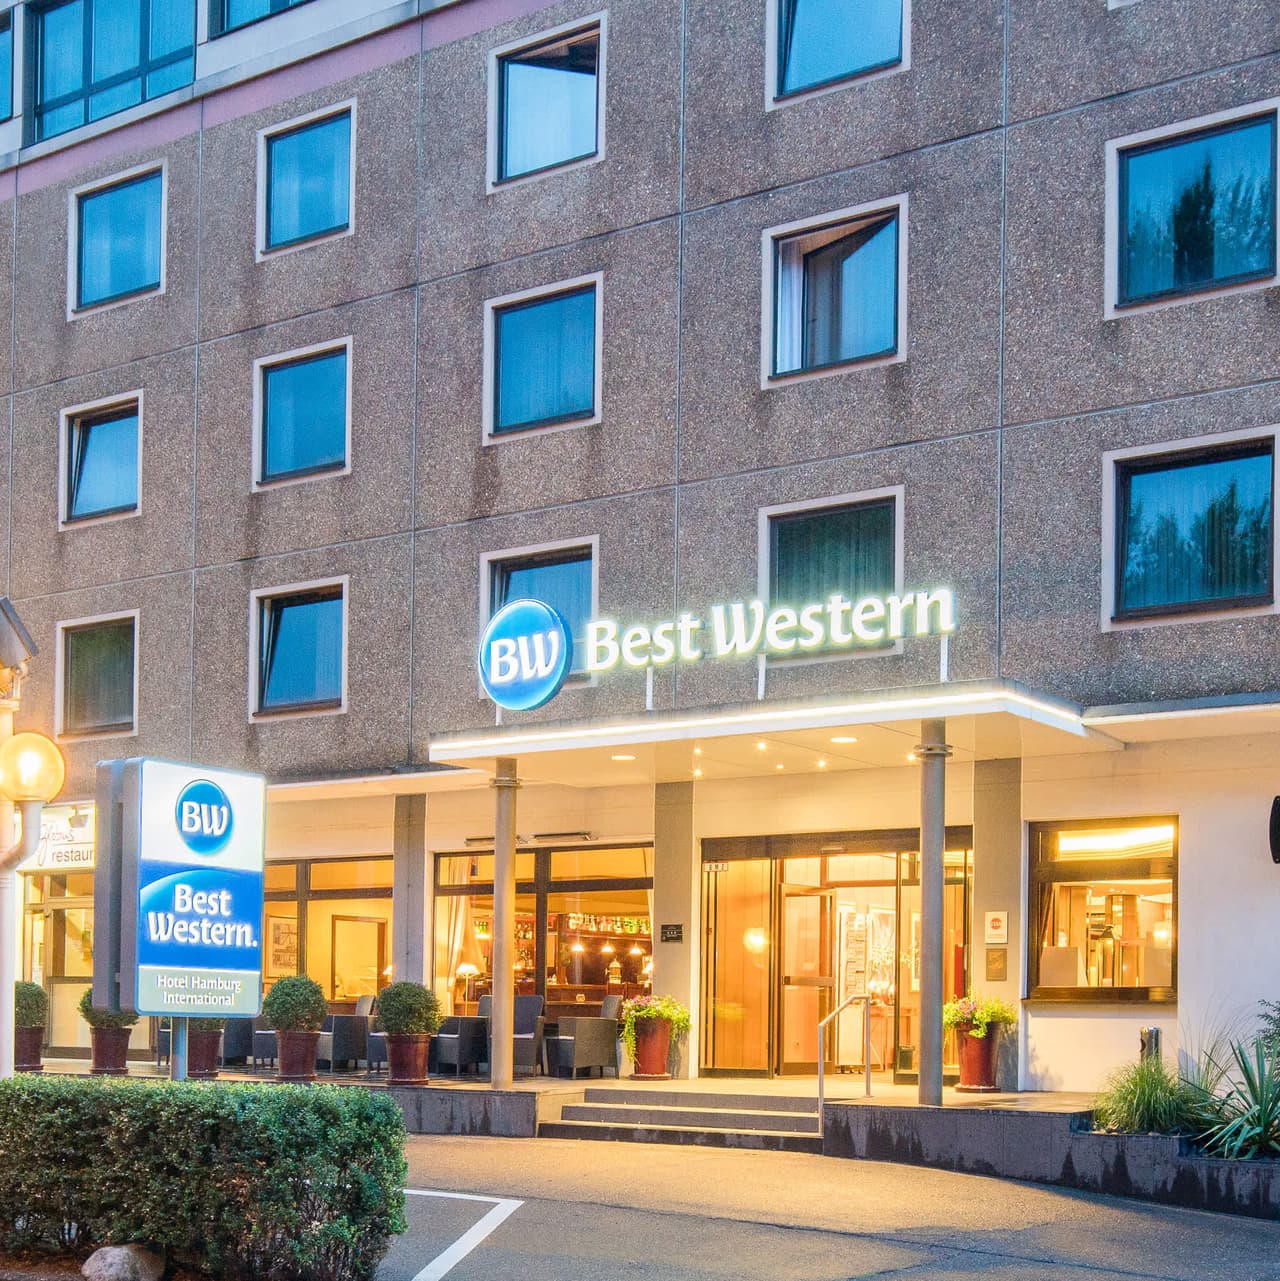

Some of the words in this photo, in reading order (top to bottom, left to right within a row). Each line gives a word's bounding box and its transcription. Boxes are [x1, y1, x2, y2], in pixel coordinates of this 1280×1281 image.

[586, 614, 703, 672] Best
[710, 588, 956, 656] Western
[490, 630, 559, 684] BW
[181, 800, 229, 837] BW
[174, 883, 232, 917] Best
[157, 974, 188, 990] Hotel
[191, 975, 241, 994] Hamburg
[163, 990, 235, 1007] International
